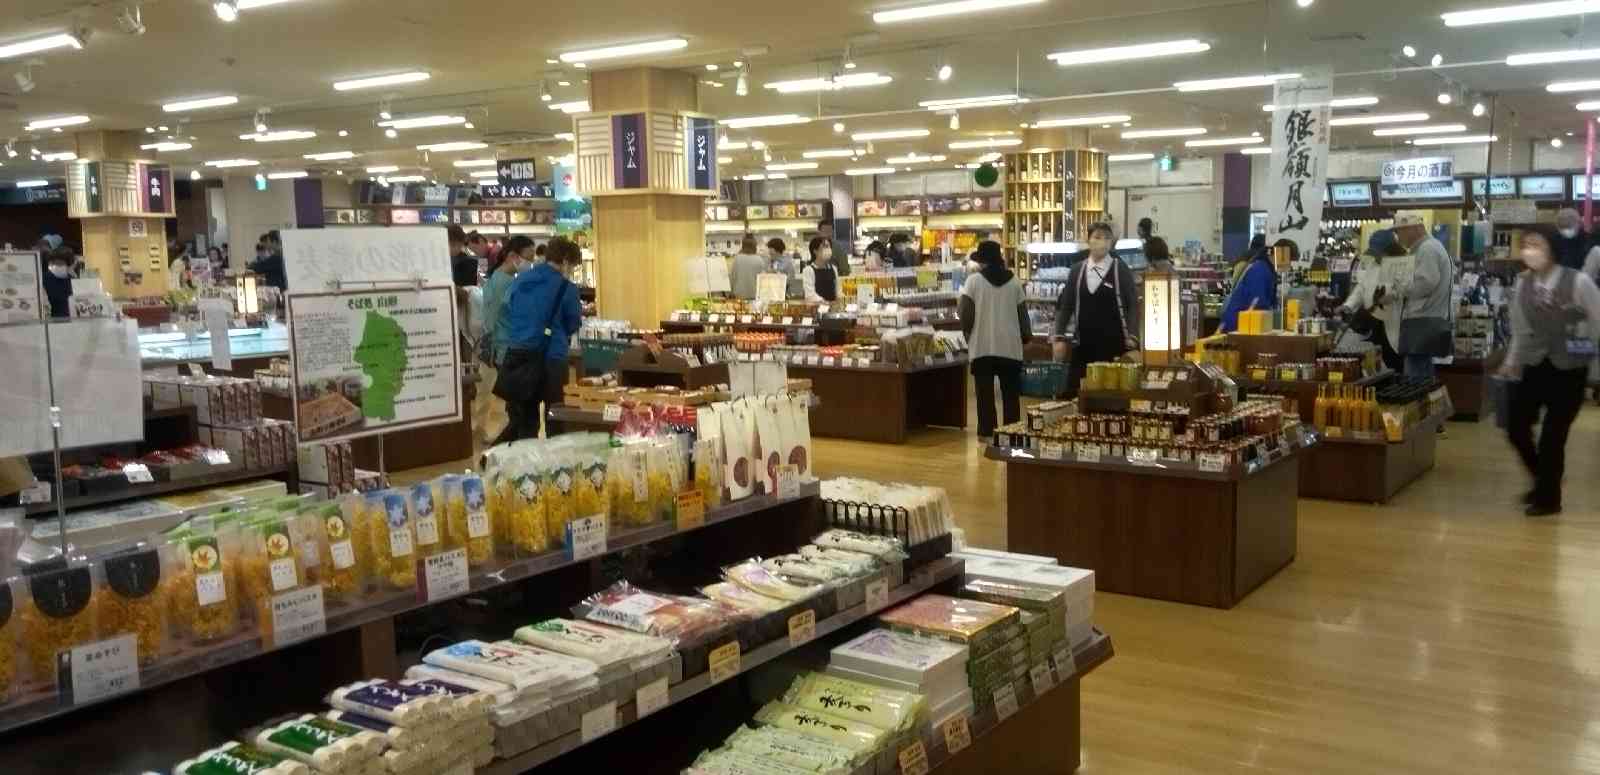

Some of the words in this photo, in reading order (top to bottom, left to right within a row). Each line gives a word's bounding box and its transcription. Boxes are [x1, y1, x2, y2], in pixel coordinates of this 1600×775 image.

[626, 130, 637, 168] ジャム
[697, 135, 706, 170] ジャム
[487, 185, 532, 198] やまがた
